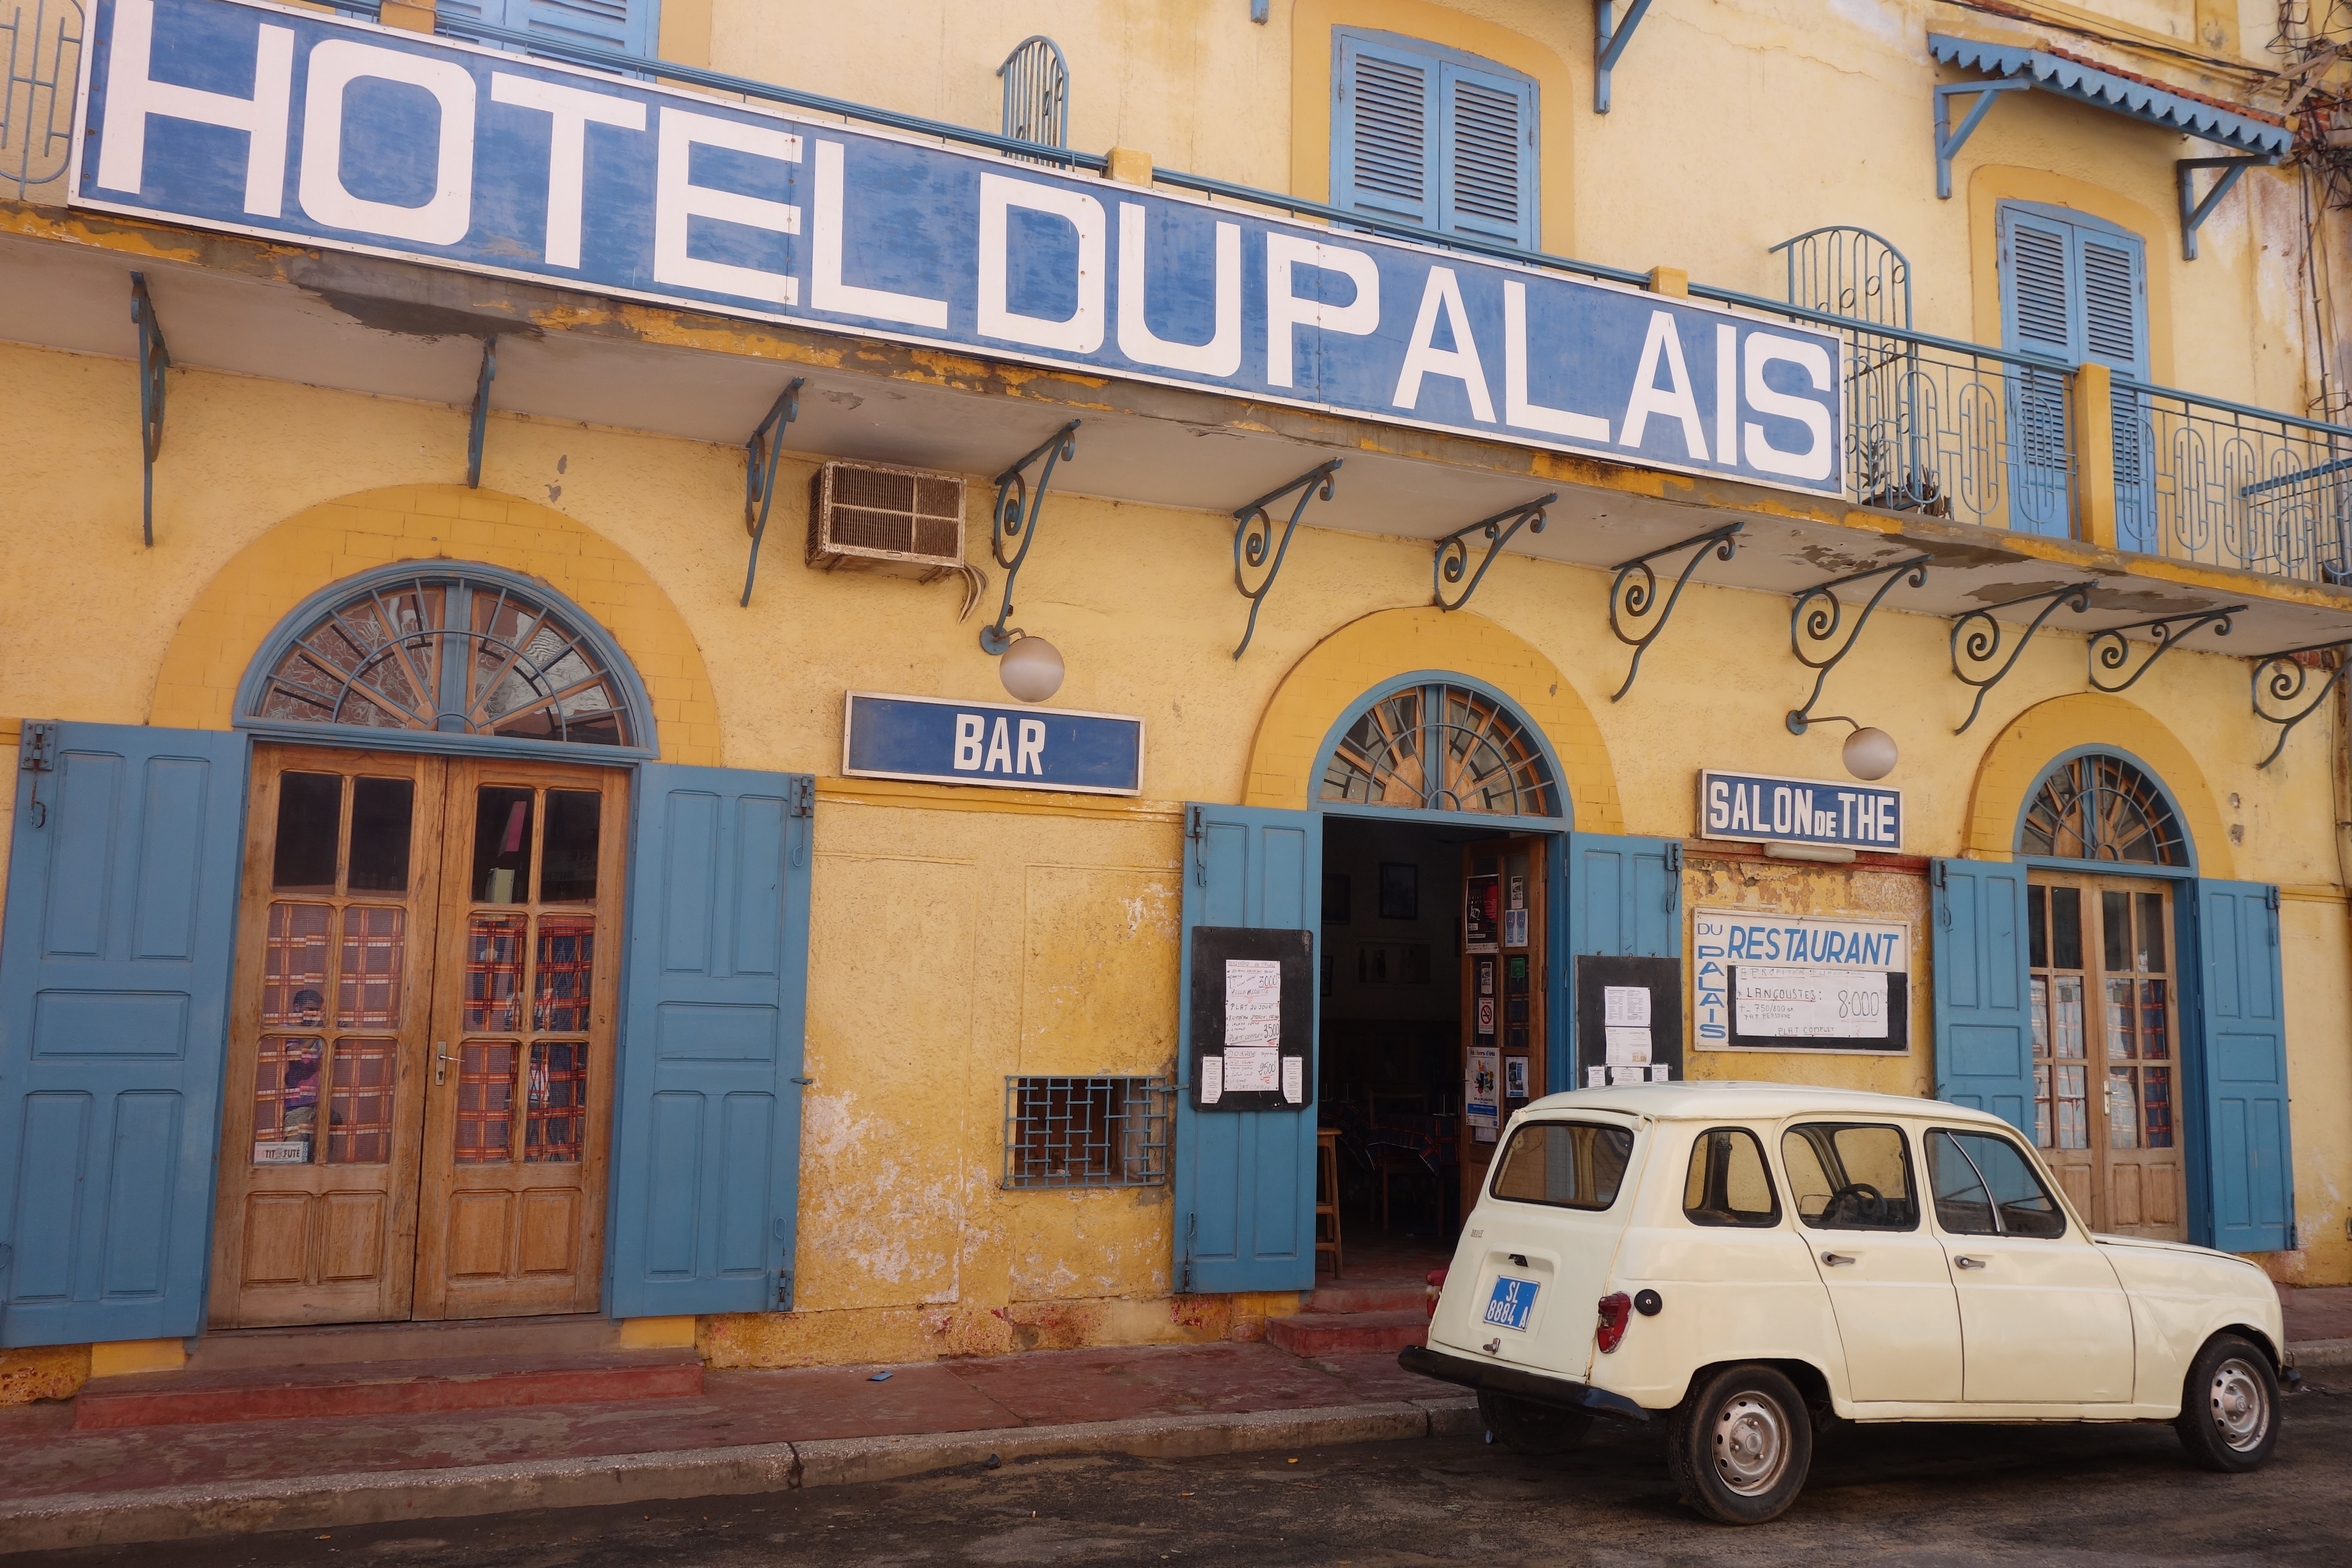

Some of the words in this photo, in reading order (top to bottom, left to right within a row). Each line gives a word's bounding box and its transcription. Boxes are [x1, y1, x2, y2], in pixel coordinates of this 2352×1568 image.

[97, 0, 948, 329] HOTEL
[977, 171, 1242, 378] DU
[1266, 230, 1832, 481] PALAIS
[953, 714, 1046, 775] BAR
[1710, 781, 1813, 836] SALON
[1814, 811, 1838, 838] DE
[1838, 793, 1895, 842] THE
[1697, 923, 1723, 936] DU
[1727, 925, 1899, 966] RESTAURANT
[1749, 968, 1805, 977] PROFITER
[1259, 975, 1278, 988] 3000
[1698, 945, 1727, 1039] PALAIS
[1755, 1003, 1785, 1013] 750/800
[1229, 1034, 1244, 1042] PLAT
[1264, 1023, 1280, 1038] 3500
[1777, 1027, 1799, 1035] PLAT
[1803, 1026, 1834, 1035] COMPLET
[284, 1147, 300, 1158] FUTÉ
[1505, 1280, 1519, 1304] SL
[1486, 1299, 1517, 1325] 8884
[1518, 1306, 1528, 1328] A
